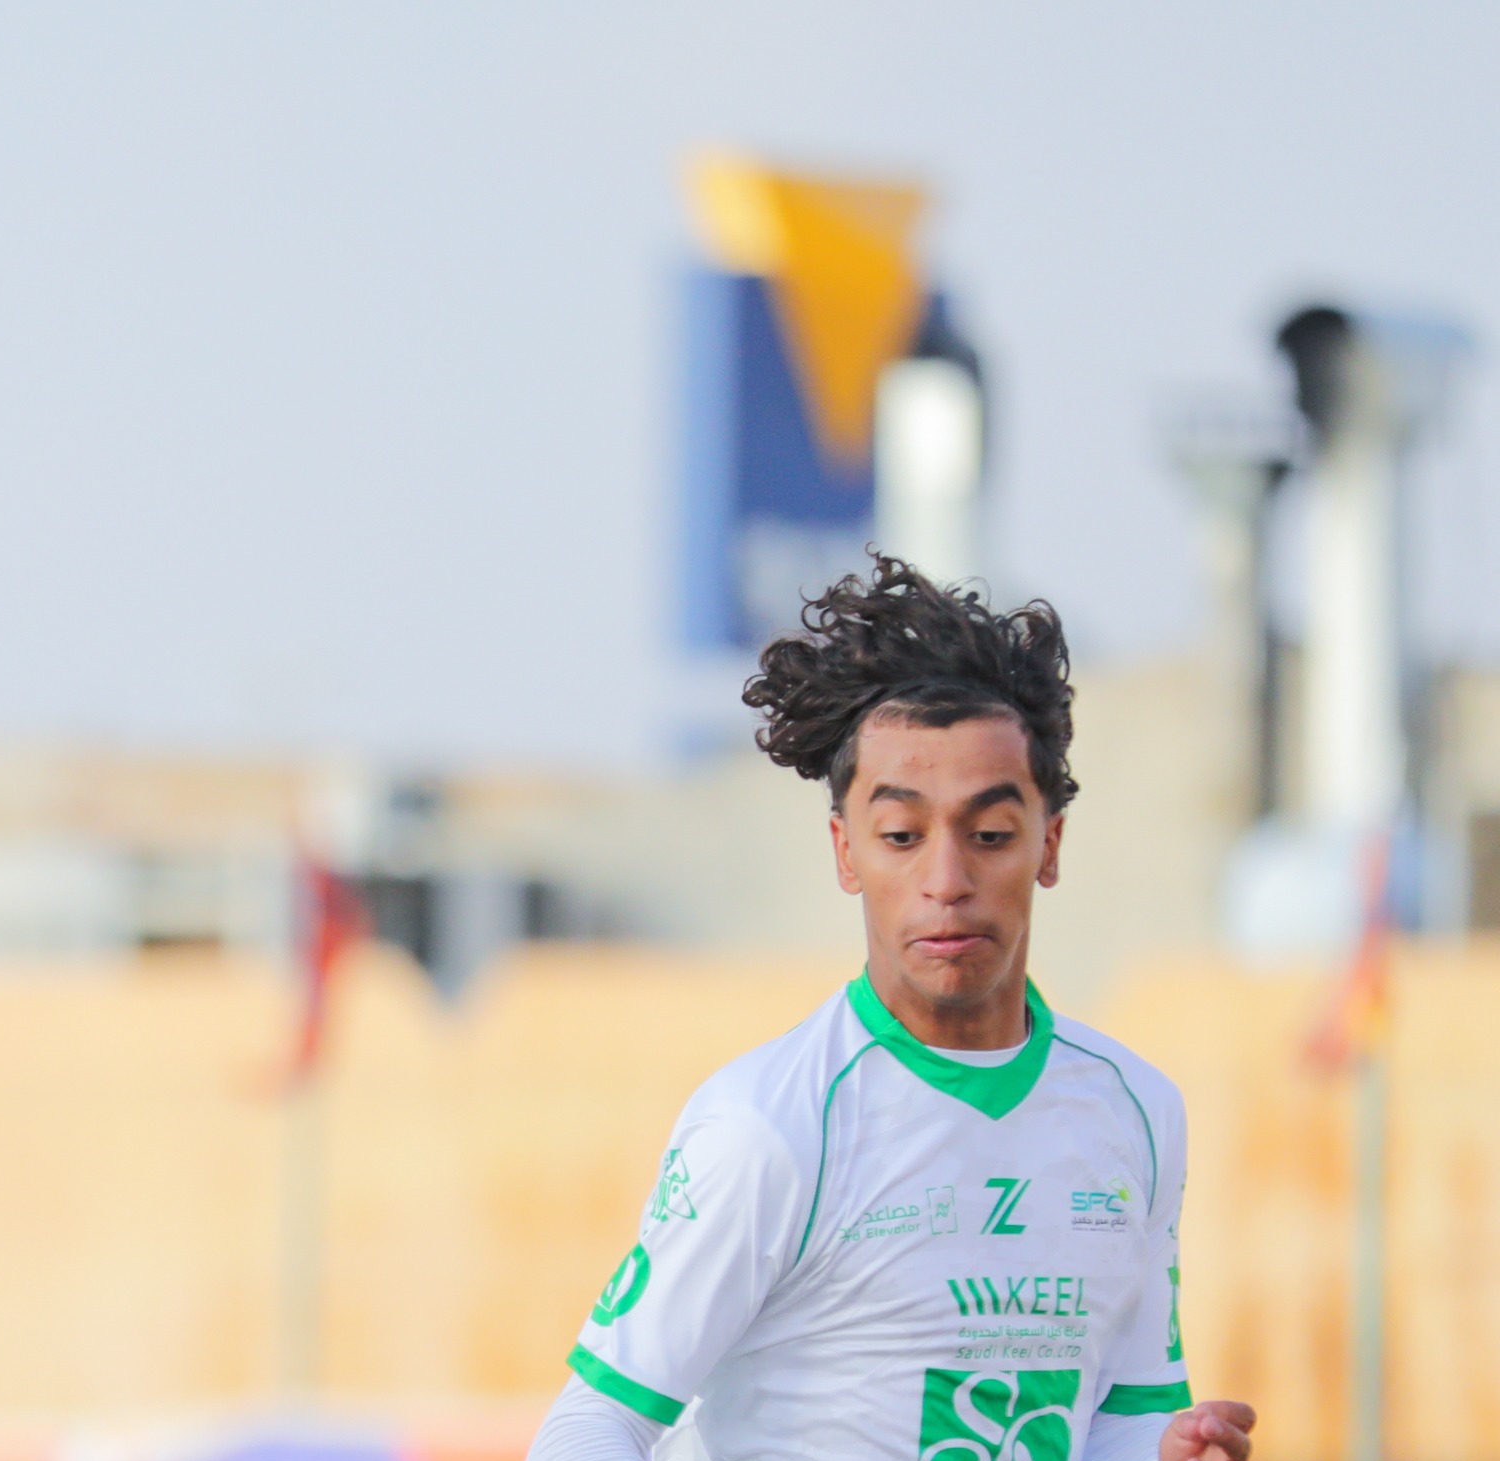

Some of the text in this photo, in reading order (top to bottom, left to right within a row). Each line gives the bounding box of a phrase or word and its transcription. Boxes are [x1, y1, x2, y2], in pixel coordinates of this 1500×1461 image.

[1071, 1192, 1124, 1213] SFC
[863, 1204, 920, 1224] مصاعد
[866, 1223, 921, 1239] Elevator
[958, 1326, 1004, 1341] المحدودة
[1005, 1325, 1045, 1340] السعودية
[956, 1345, 996, 1360] Saudi
[1002, 1345, 1032, 1360] Keel
